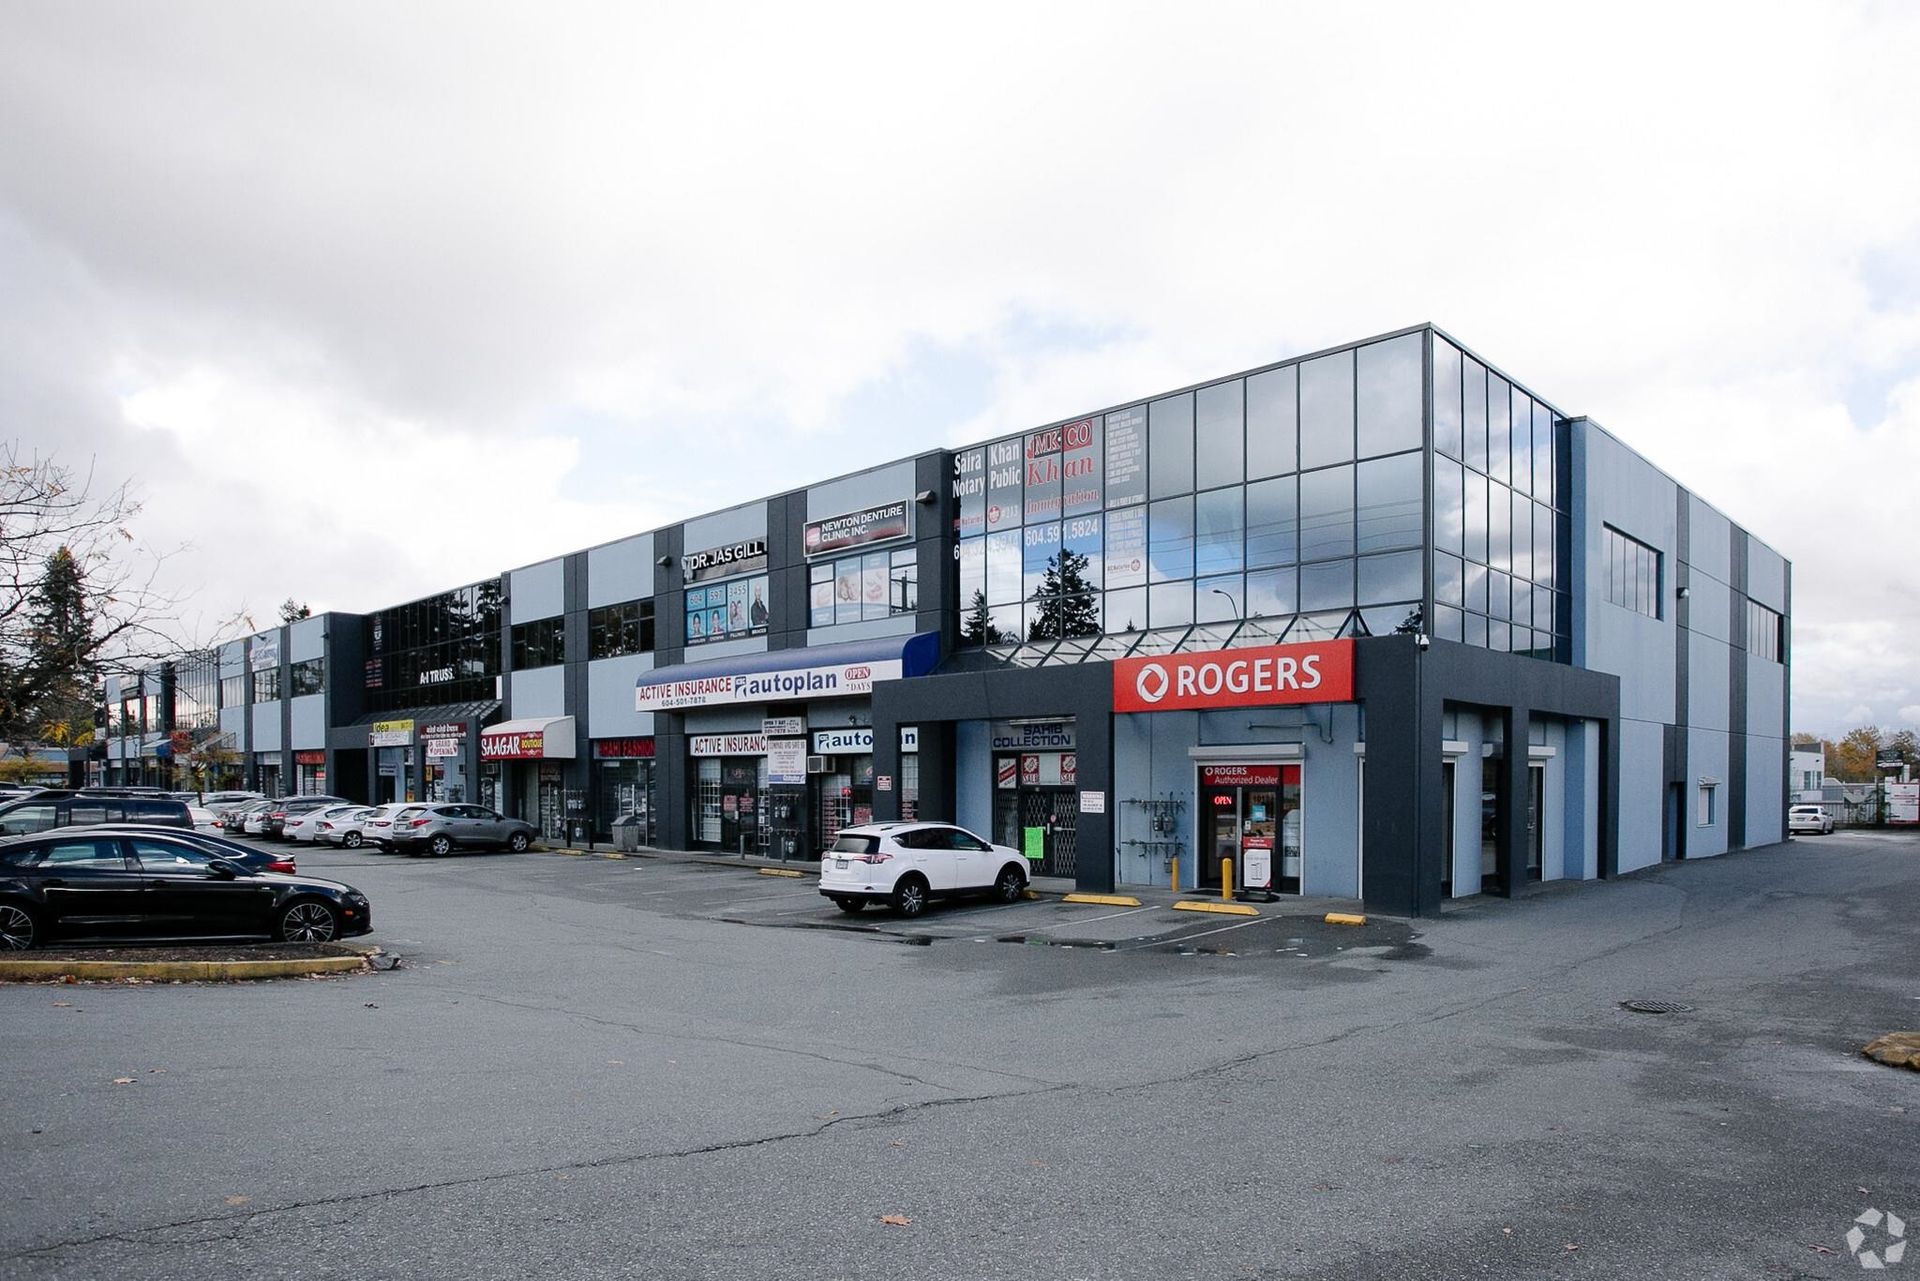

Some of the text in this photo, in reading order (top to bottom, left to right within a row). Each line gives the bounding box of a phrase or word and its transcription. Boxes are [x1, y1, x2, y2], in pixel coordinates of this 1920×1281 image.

[954, 443, 1020, 475] Saira Khan
[1026, 457, 1094, 487] Khan
[952, 466, 1021, 499] Notary Public
[822, 505, 903, 533] NEWTON DENTURE
[822, 524, 869, 542] CLINIC INC.
[691, 541, 763, 570] DR. JAS GILL
[729, 583, 747, 597] 3455
[846, 667, 870, 679] OPEN
[1177, 654, 1322, 697] ROGERS
[640, 677, 732, 701] ACTIVE INSURANCE
[749, 671, 837, 695] autoplan
[850, 682, 871, 691] DAYS
[1023, 724, 1063, 735] SAHIB
[481, 735, 520, 756] SAAGAR
[521, 738, 543, 748] BOUTIQUE
[695, 735, 768, 754] ACTIVE INSURANC
[993, 734, 1071, 748] COLLECTION
[433, 747, 454, 755] OPENING
[1214, 766, 1247, 775] ROGERS
[1214, 775, 1278, 785] Authorized Dealer
[1214, 795, 1232, 805] OPEN
